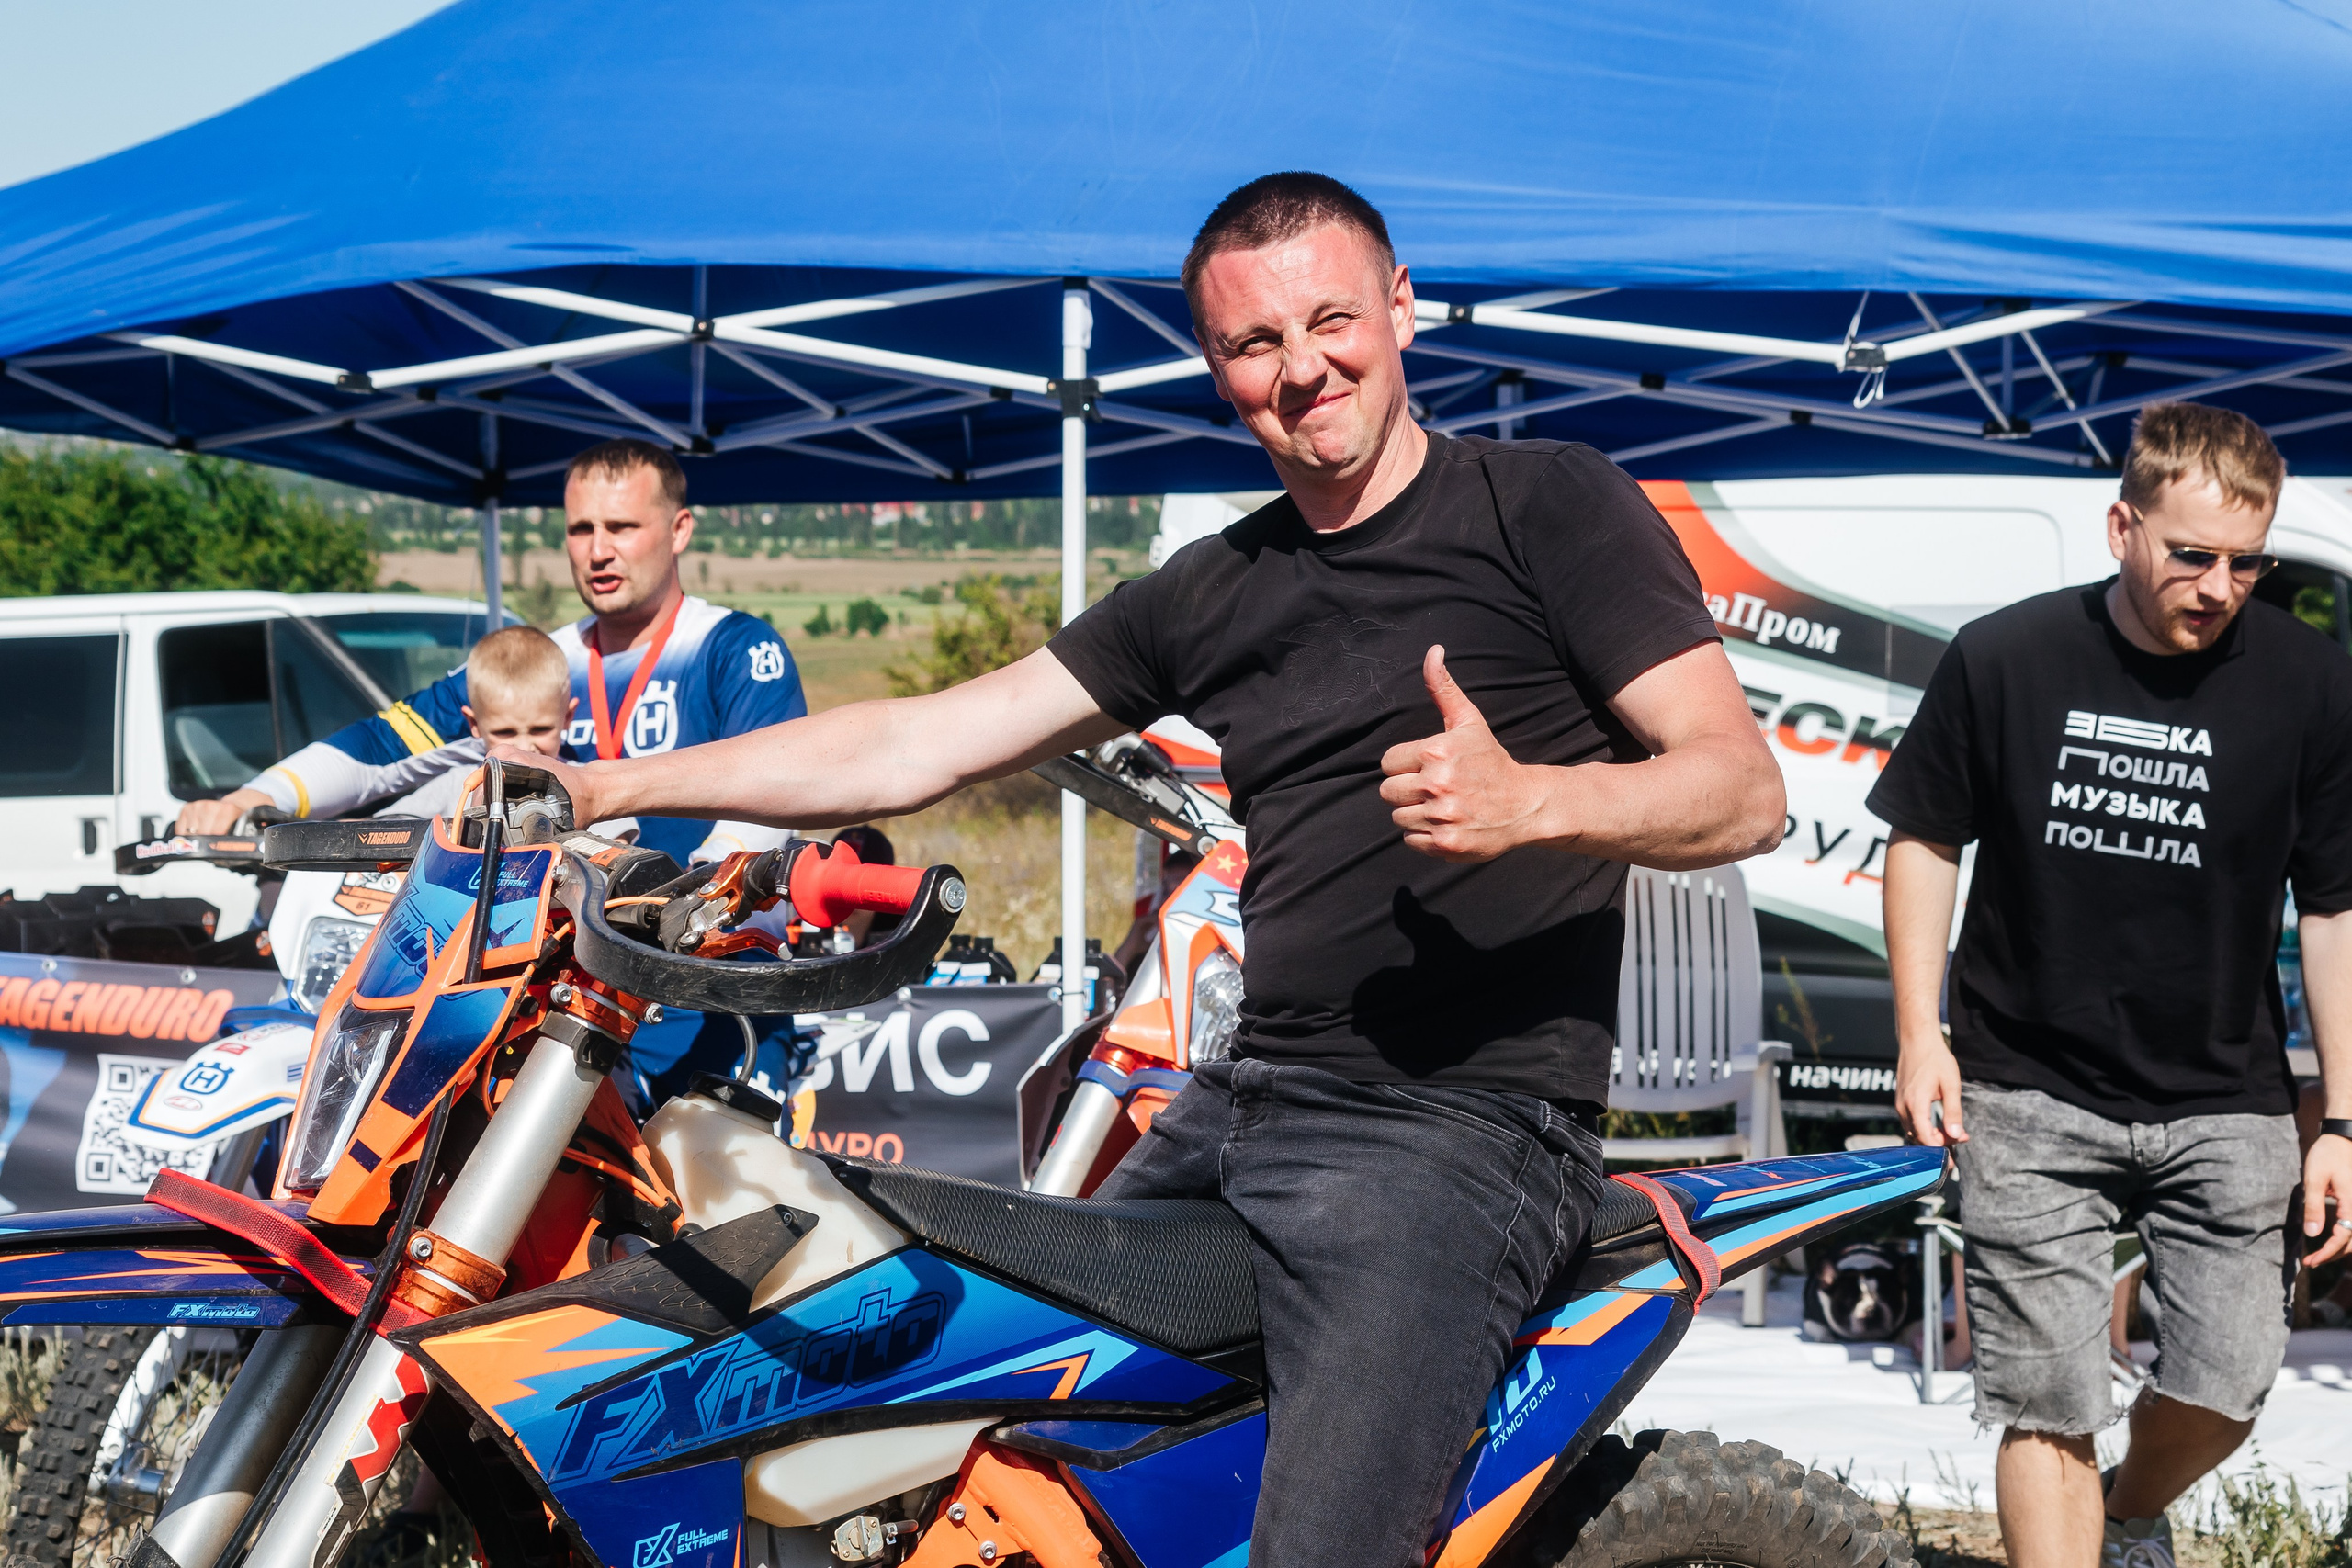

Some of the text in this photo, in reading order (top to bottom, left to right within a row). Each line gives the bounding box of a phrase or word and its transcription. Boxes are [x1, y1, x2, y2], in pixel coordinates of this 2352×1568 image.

[1702, 591, 1842, 654] аПром
[2057, 745, 2210, 792] ПОШЛА
[2050, 781, 2206, 829] МУЗЫКА
[367, 830, 411, 845] TAGENDURO
[2044, 820, 2202, 868] ПОШЛА
[498, 871, 516, 879] FULL
[815, 1009, 993, 1096] ИС
[1791, 1063, 1897, 1092] начин
[808, 1131, 905, 1165] УРО
[167, 1303, 261, 1319] FXmoto
[548, 1288, 947, 1478] FXmoto
[1491, 1375, 1556, 1453] FXMOTO.RU
[676, 1529, 729, 1555] EXTREME
[677, 1528, 707, 1544] FULL
